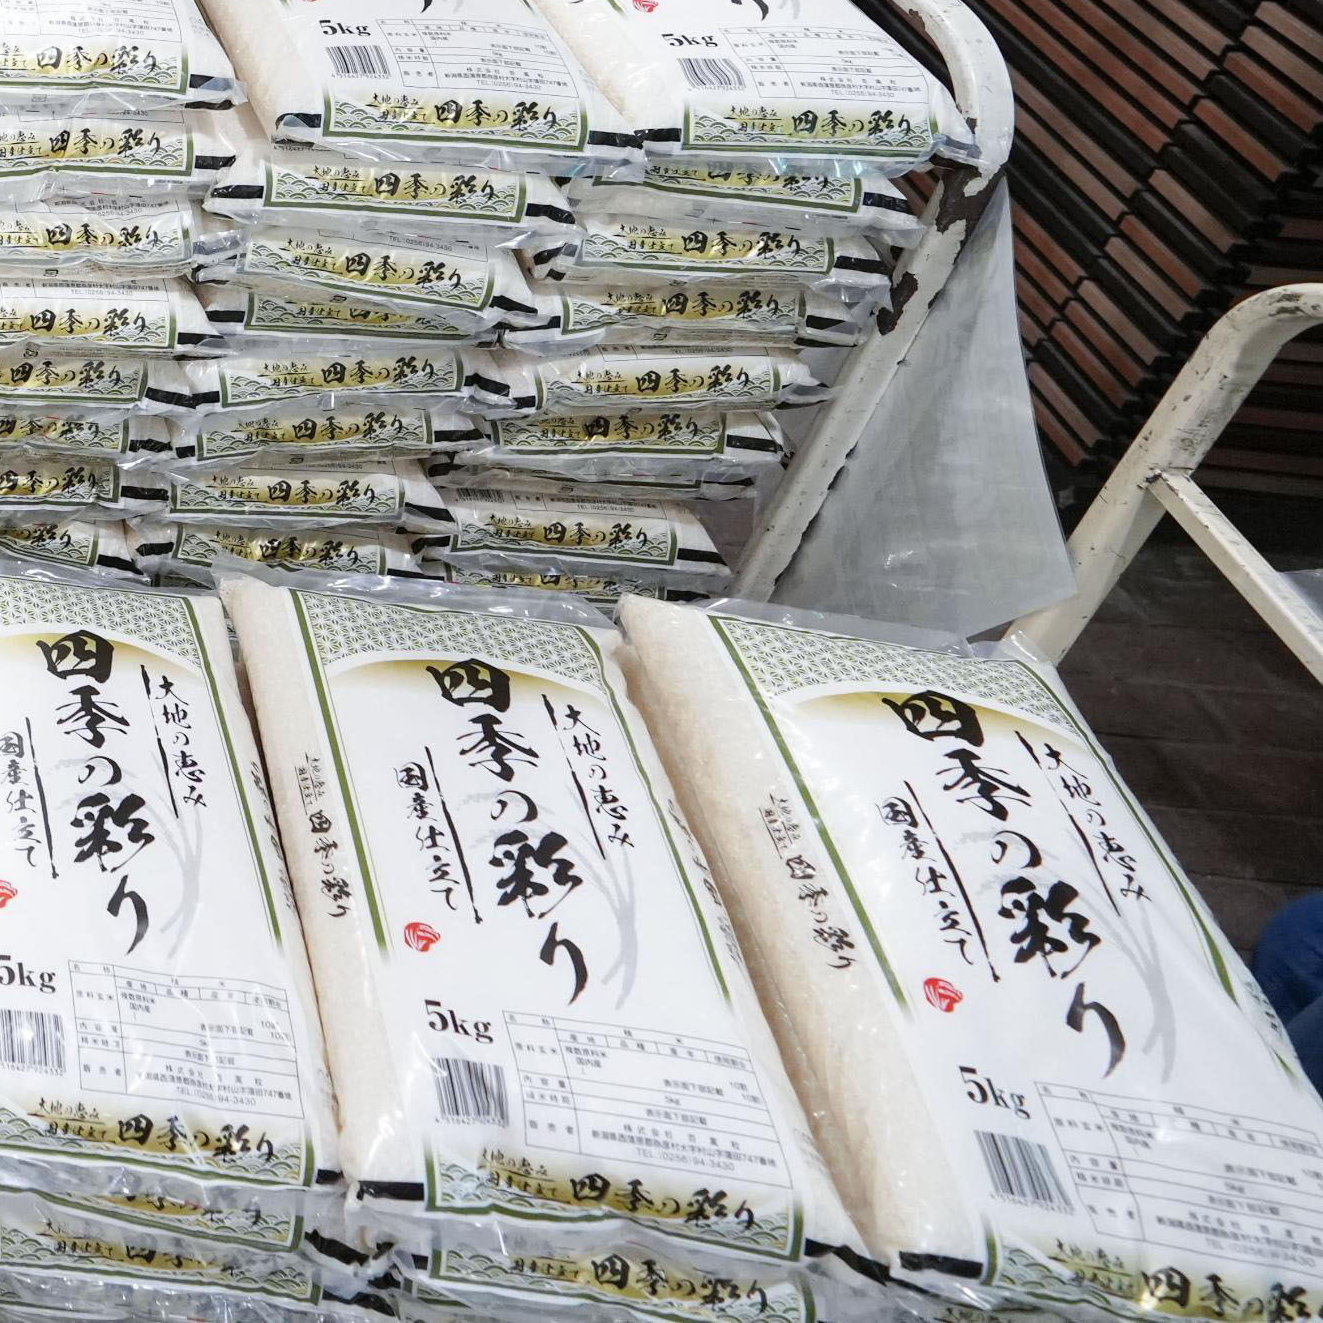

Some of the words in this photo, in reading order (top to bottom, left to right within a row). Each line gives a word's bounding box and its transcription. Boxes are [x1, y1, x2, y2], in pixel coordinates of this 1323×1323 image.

[318, 19, 372, 39] 5kg
[662, 31, 720, 50] 5kg
[423, 998, 495, 1046] 5kg
[957, 1065, 1032, 1120] 5kg
